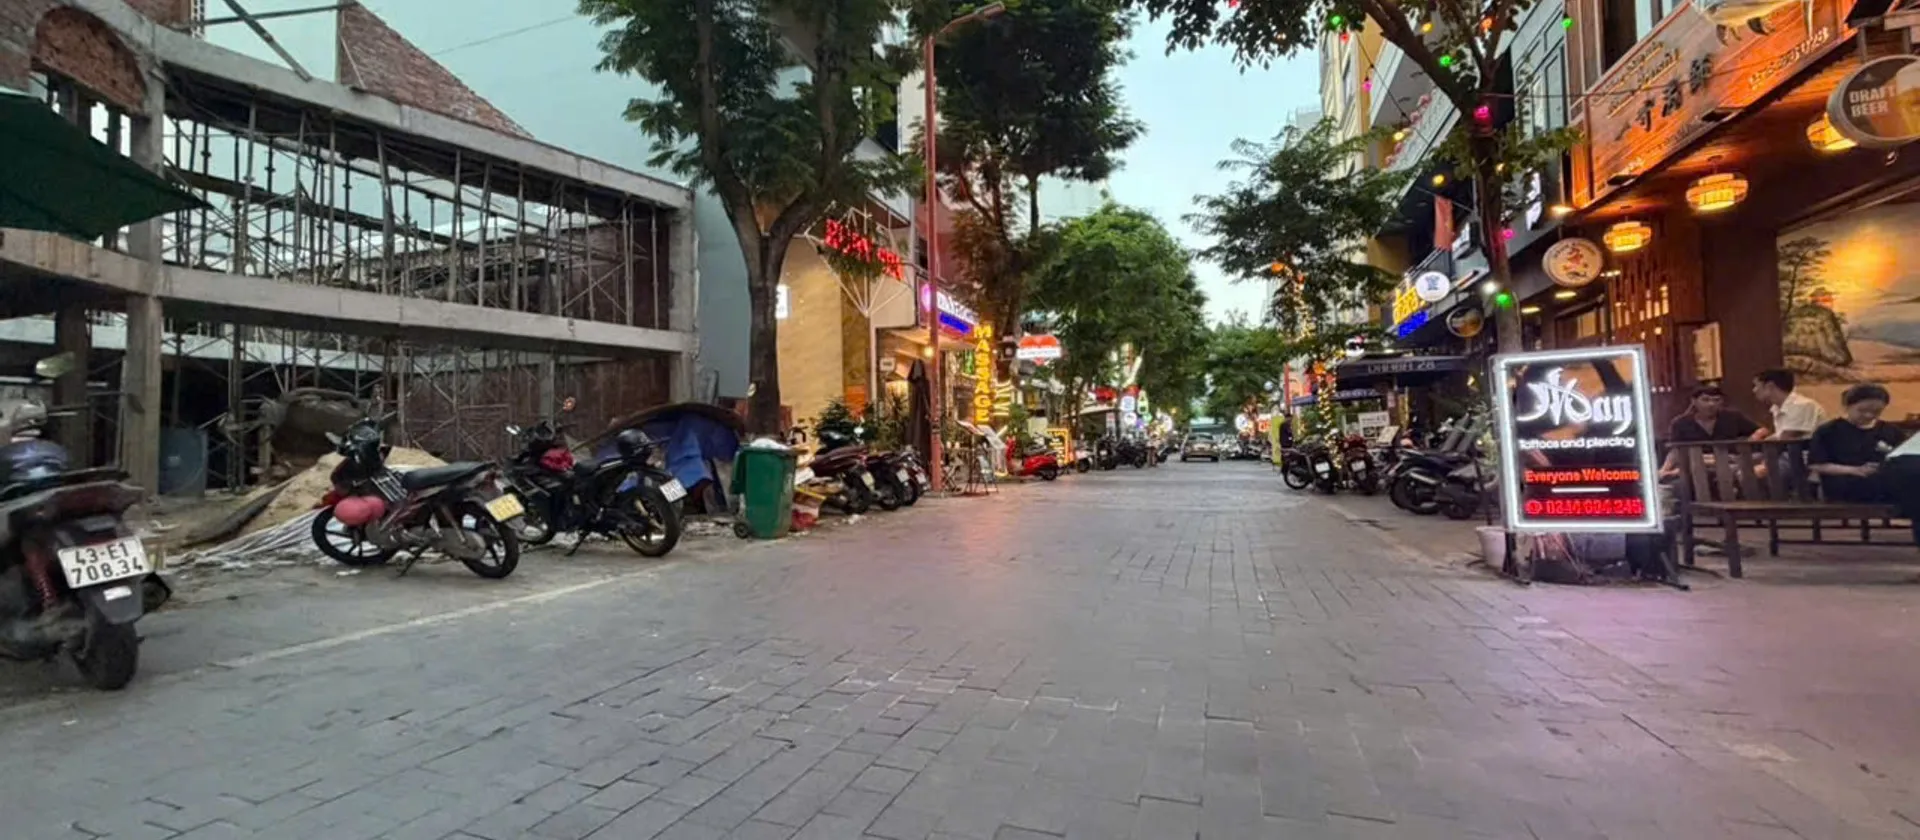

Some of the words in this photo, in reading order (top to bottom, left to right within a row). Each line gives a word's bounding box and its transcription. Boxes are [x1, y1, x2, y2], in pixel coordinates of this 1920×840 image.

[1848, 84, 1897, 103] DRAFT
[1850, 100, 1889, 118] BEER
[973, 323, 993, 422] MASSAGE
[1518, 439, 1559, 450] Tattoos
[1560, 438, 1585, 448] and
[1586, 437, 1635, 450] piercing
[1525, 469, 1580, 484] Everyone
[1582, 468, 1639, 481] Welcome
[75, 541, 129, 565] 43-E1
[71, 556, 144, 585] 708.34
